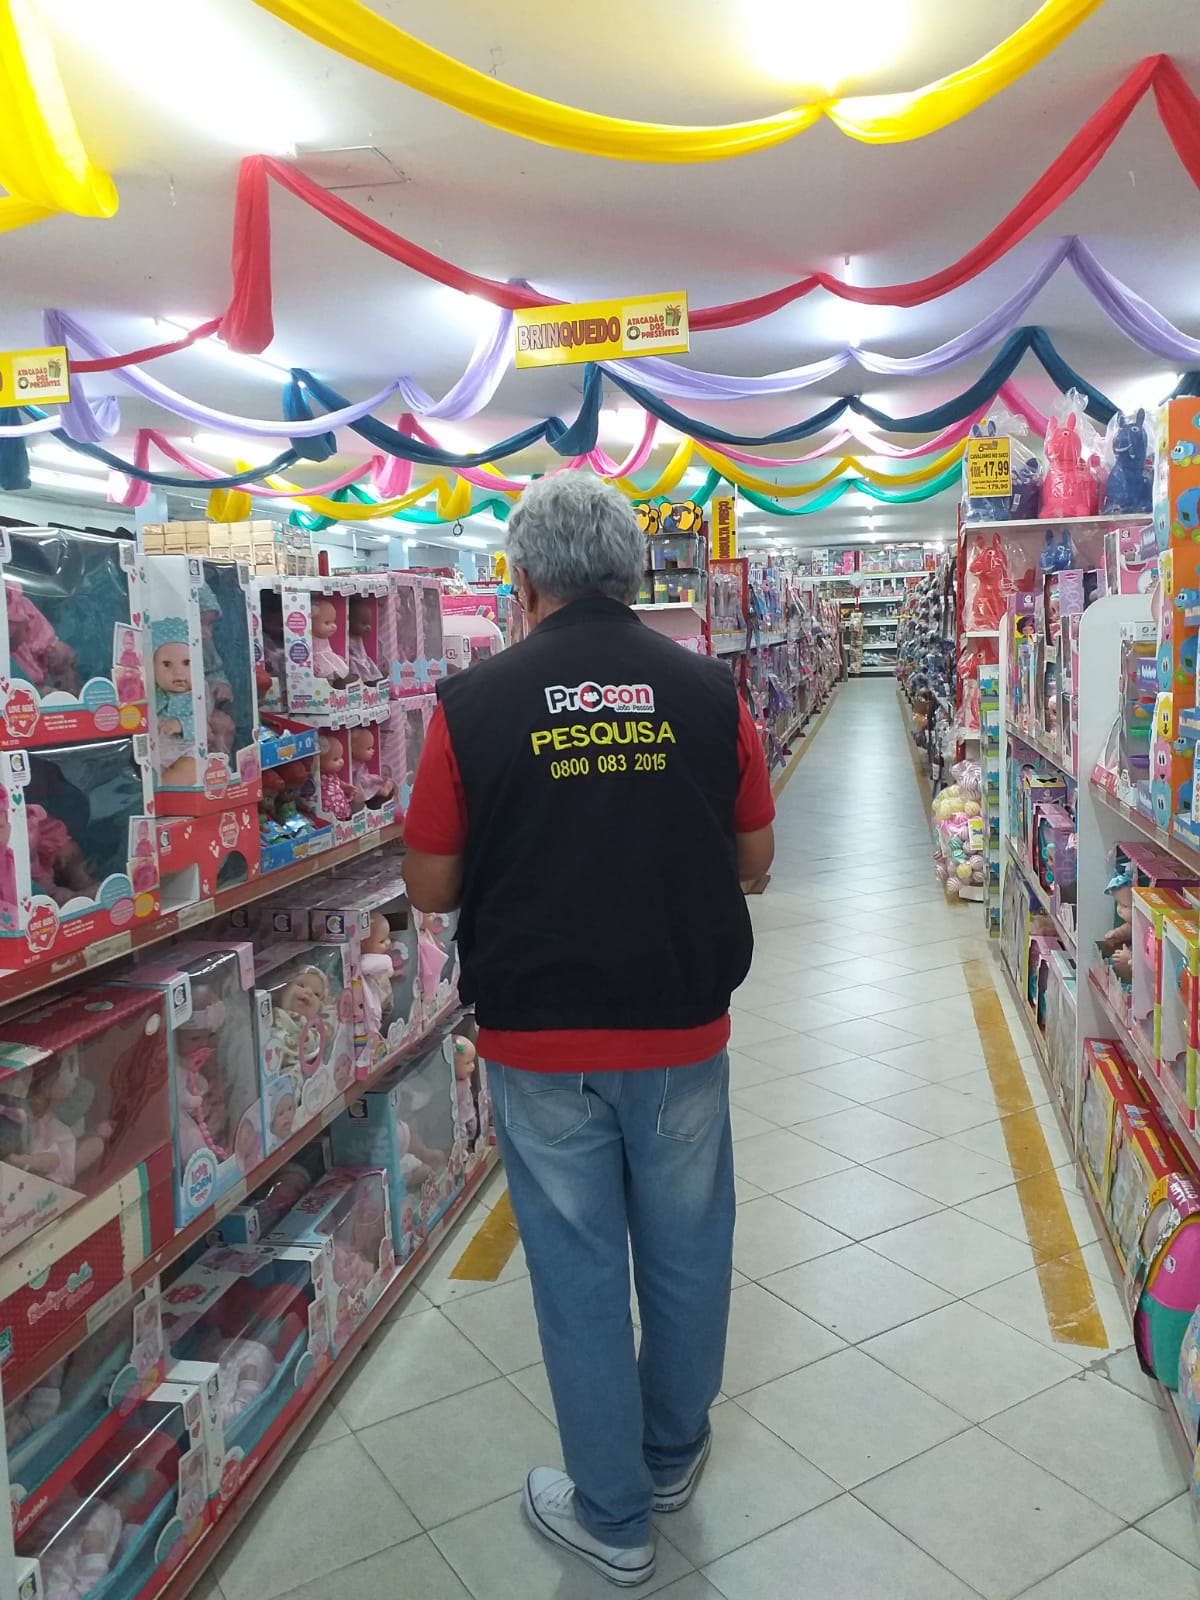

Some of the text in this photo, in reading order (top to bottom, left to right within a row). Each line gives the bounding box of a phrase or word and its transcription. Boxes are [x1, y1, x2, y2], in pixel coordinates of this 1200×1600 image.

[627, 314, 664, 326] ATACADÃO
[649, 323, 665, 331] DOS
[517, 316, 621, 352] BRINQUEDO
[641, 328, 680, 340] PRESENTES
[718, 526, 729, 558] ONSULTA
[548, 681, 651, 711] Procon
[616, 704, 653, 712] João Pessoa
[530, 721, 677, 755] PESQUISA
[550, 753, 667, 779] 0800 083 2015
[1170, 1182, 1187, 1205] KITTY
